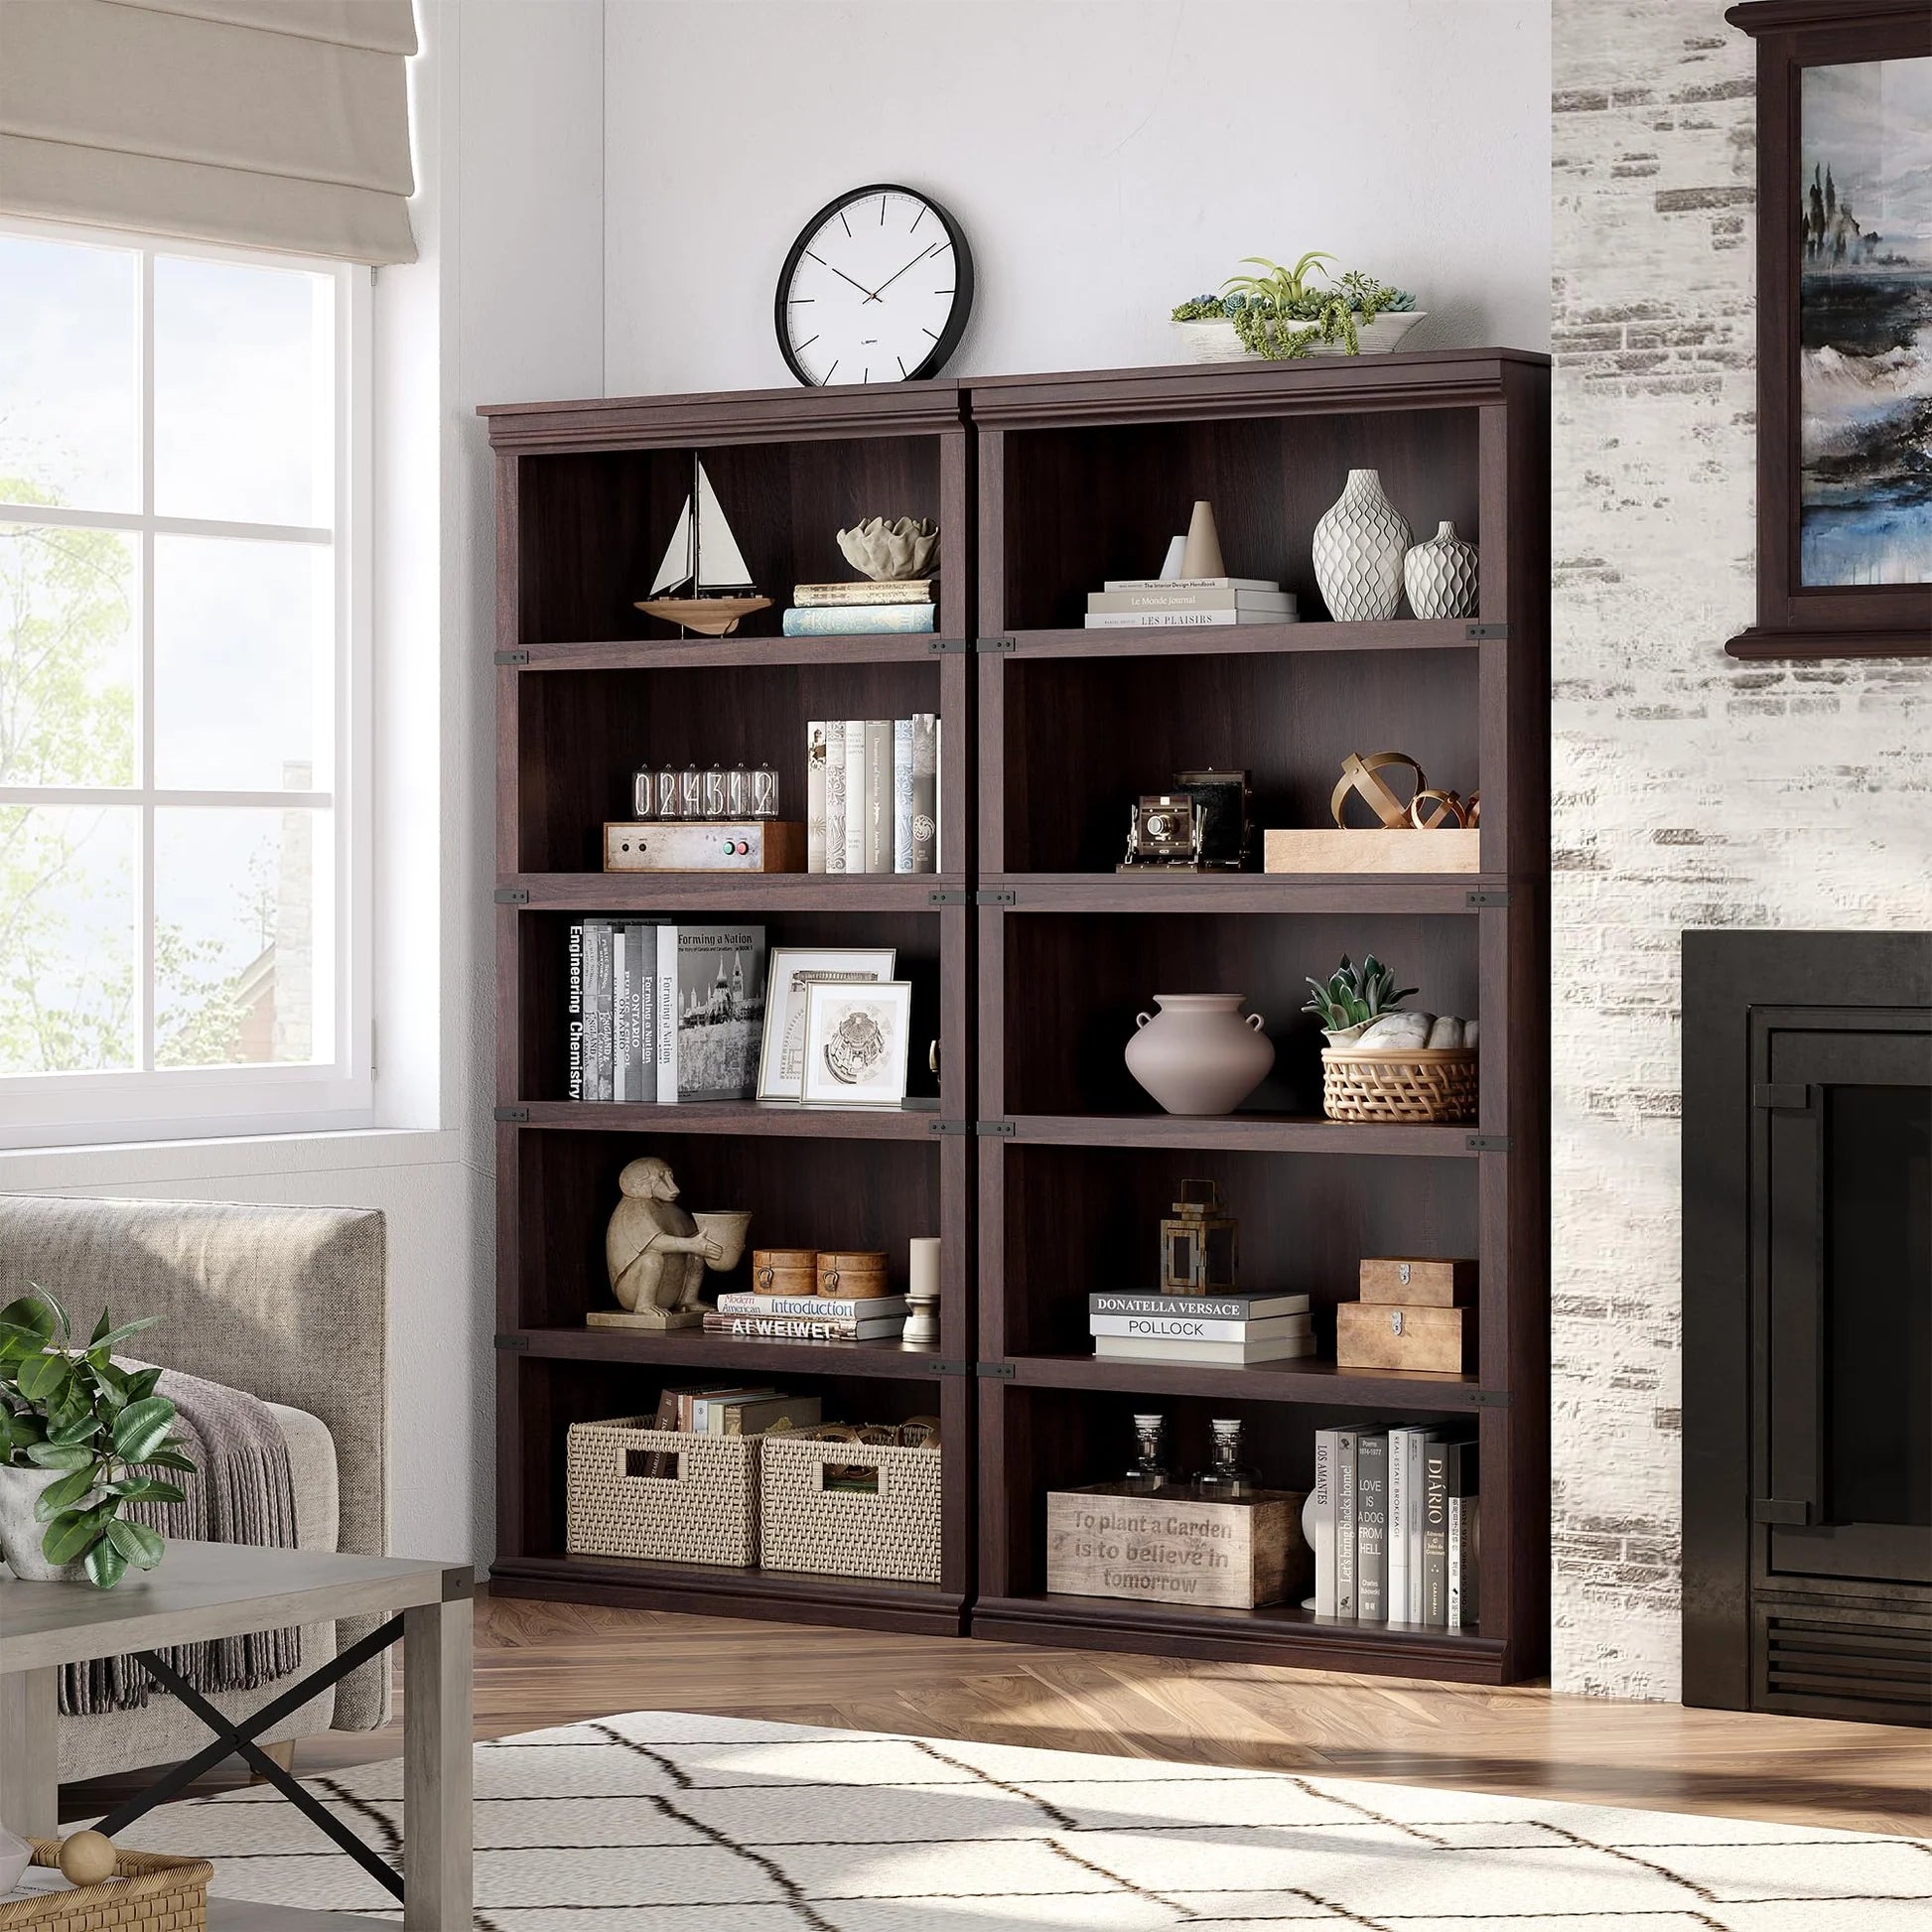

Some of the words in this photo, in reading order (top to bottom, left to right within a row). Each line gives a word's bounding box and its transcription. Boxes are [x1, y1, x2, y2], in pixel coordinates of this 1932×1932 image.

[1142, 596, 1168, 606] Monde
[1168, 595, 1196, 606] Journal
[1142, 616, 1160, 625] LES
[1165, 615, 1213, 625] PLAISIRS
[678, 933, 716, 946] Forming
[724, 932, 753, 944] Nation
[569, 926, 583, 1014] Engineering
[644, 976, 653, 1020] Forming
[662, 976, 672, 1021] Forming
[584, 1011, 598, 1054] ENGLAND
[598, 1010, 612, 1054] ENGLAND
[631, 994, 640, 1048] ONTARIO
[644, 1031, 653, 1064] Nation
[662, 1031, 673, 1064] Nation
[569, 1022, 583, 1099] Chemistry
[722, 1303, 761, 1314] American
[724, 1294, 755, 1305] Modern
[770, 1299, 853, 1316] Introduction
[1097, 1298, 1176, 1312] DONATELLA
[1178, 1302, 1240, 1316] VERSACE
[732, 1318, 751, 1335] AI
[756, 1319, 831, 1339] WEIWEI
[1129, 1320, 1204, 1336] POLLOCK
[1316, 1445, 1328, 1462] LOS
[1316, 1463, 1328, 1506] AMANTES
[1340, 1464, 1352, 1497] home!
[1359, 1479, 1382, 1492] LOVE
[1428, 1457, 1447, 1525] DIÁRIO
[1340, 1497, 1352, 1530] blacks
[1365, 1495, 1374, 1508] IS
[1074, 1510, 1095, 1529] To
[1099, 1512, 1148, 1534] plant
[1151, 1520, 1162, 1533] a
[1167, 1517, 1233, 1539] Garden
[1358, 1511, 1367, 1523] A
[1367, 1511, 1385, 1524] DOG
[1341, 1531, 1355, 1559] bring
[1358, 1527, 1383, 1540] FROM
[1074, 1538, 1091, 1558] is
[1097, 1540, 1120, 1560] to
[1126, 1542, 1203, 1567] believe
[1208, 1547, 1229, 1569] in
[1359, 1543, 1382, 1556] HELL
[1103, 1569, 1198, 1594] tomorrow
[1341, 1560, 1352, 1584] Let's
